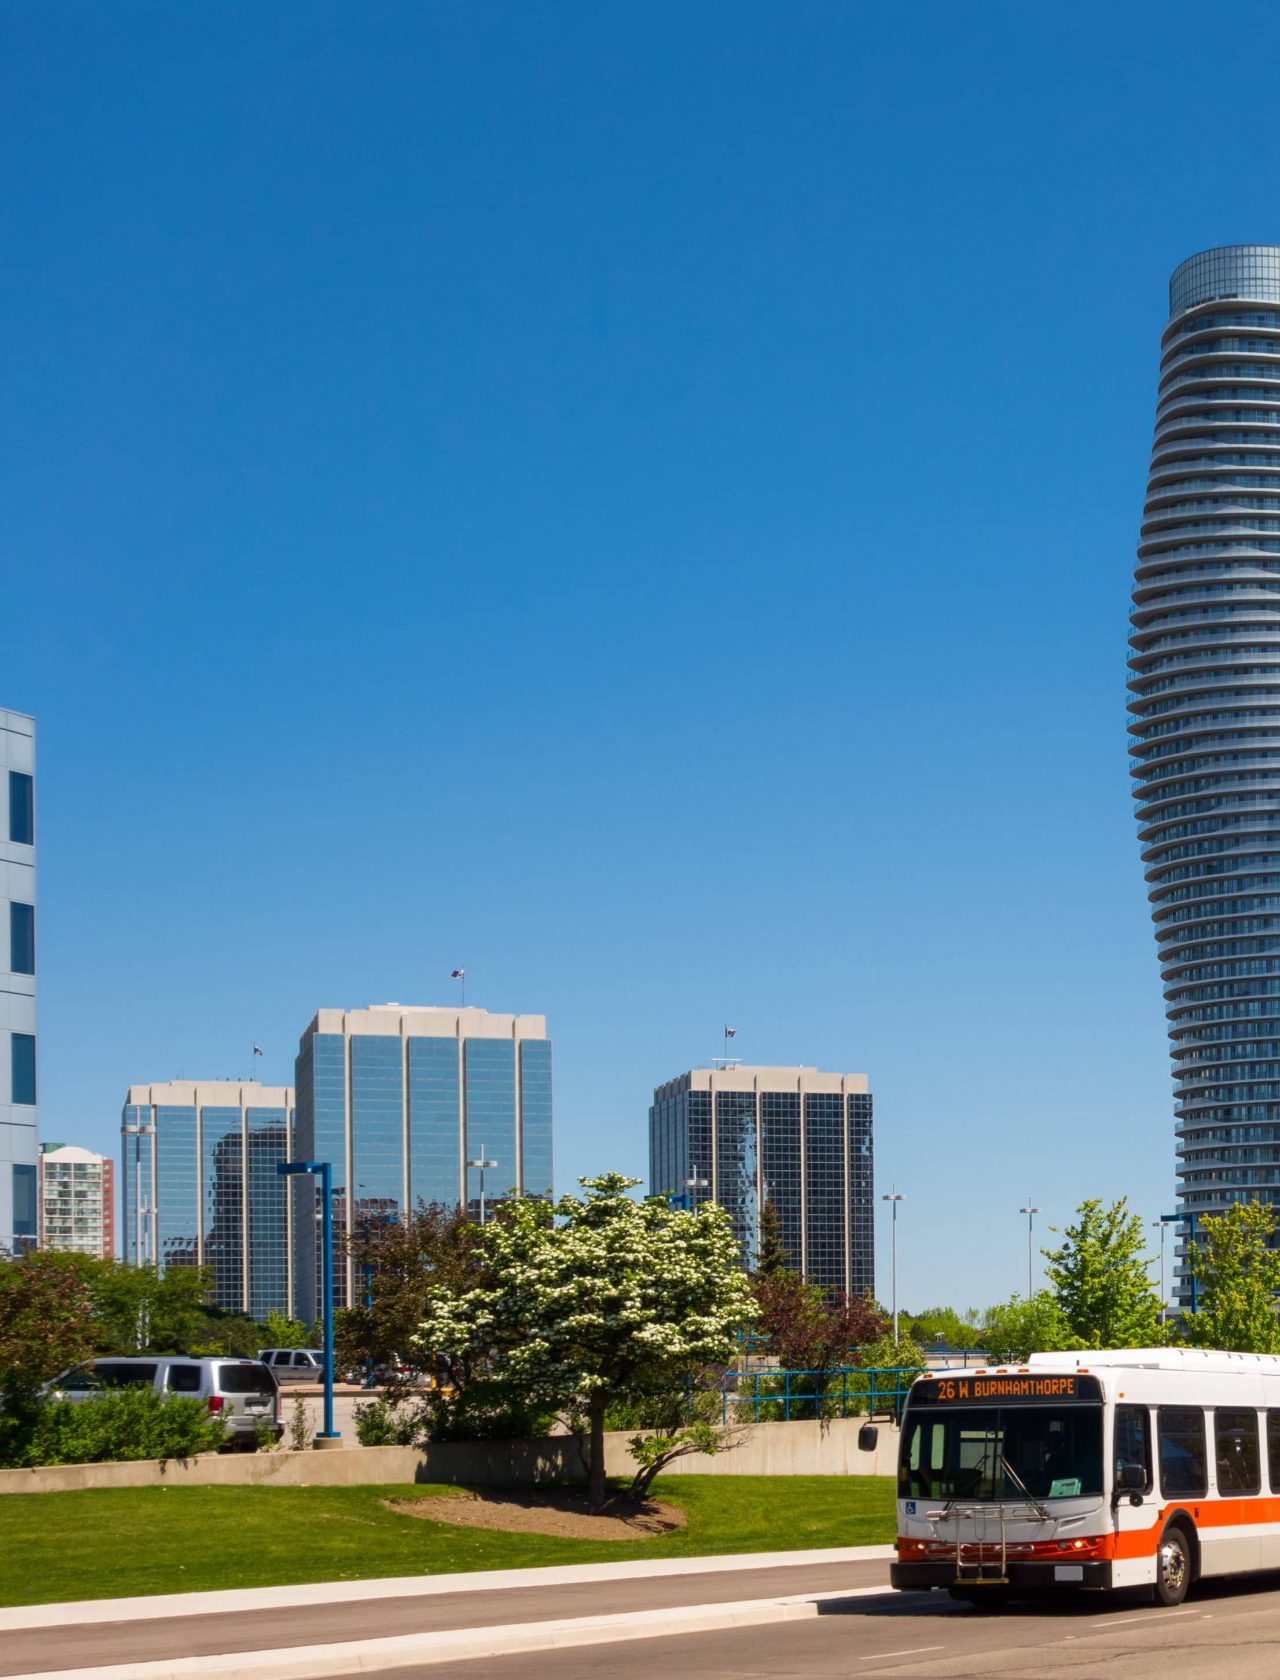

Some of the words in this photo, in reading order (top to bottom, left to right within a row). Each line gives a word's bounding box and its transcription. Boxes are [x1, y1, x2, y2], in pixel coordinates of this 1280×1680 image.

[937, 1381, 955, 1399] 26
[959, 1381, 969, 1399] W
[974, 1378, 1074, 1396] BURNHAMTHORPE
